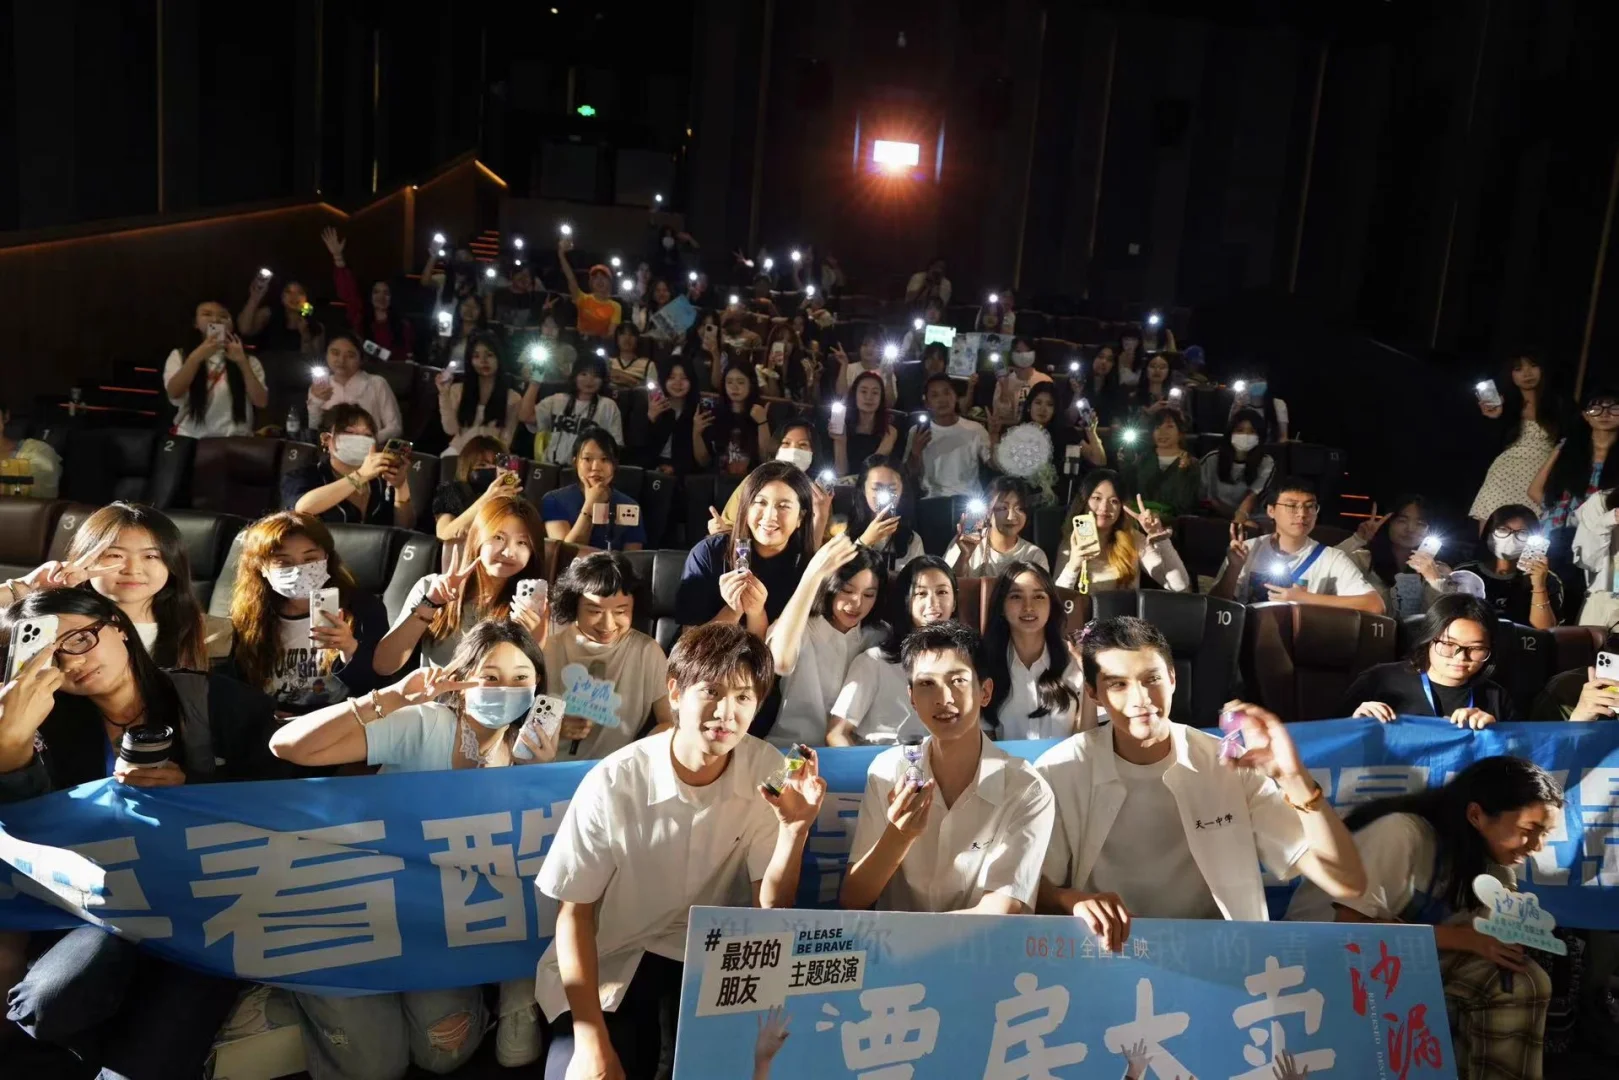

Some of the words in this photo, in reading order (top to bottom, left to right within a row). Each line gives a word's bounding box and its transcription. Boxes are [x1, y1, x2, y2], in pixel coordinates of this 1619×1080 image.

[163, 440, 175, 452] 2
[288, 449, 298, 461] 3
[1329, 452, 1340, 461] 13
[412, 460, 422, 472] 4
[533, 468, 542, 480] 5
[652, 479, 661, 491] 6
[63, 514, 75, 530] 3
[402, 545, 417, 561] 5
[1064, 599, 1075, 615] 9
[1216, 610, 1232, 626] 10
[1371, 622, 1384, 638] 11
[1521, 636, 1537, 651] 12
[799, 928, 843, 941] PLEASE
[797, 944, 811, 954] BE
[815, 940, 853, 953] BRAVE
[788, 957, 859, 988] 主题路演
[716, 975, 760, 1006] 朋友
[1344, 940, 1442, 1080] 沙漏
